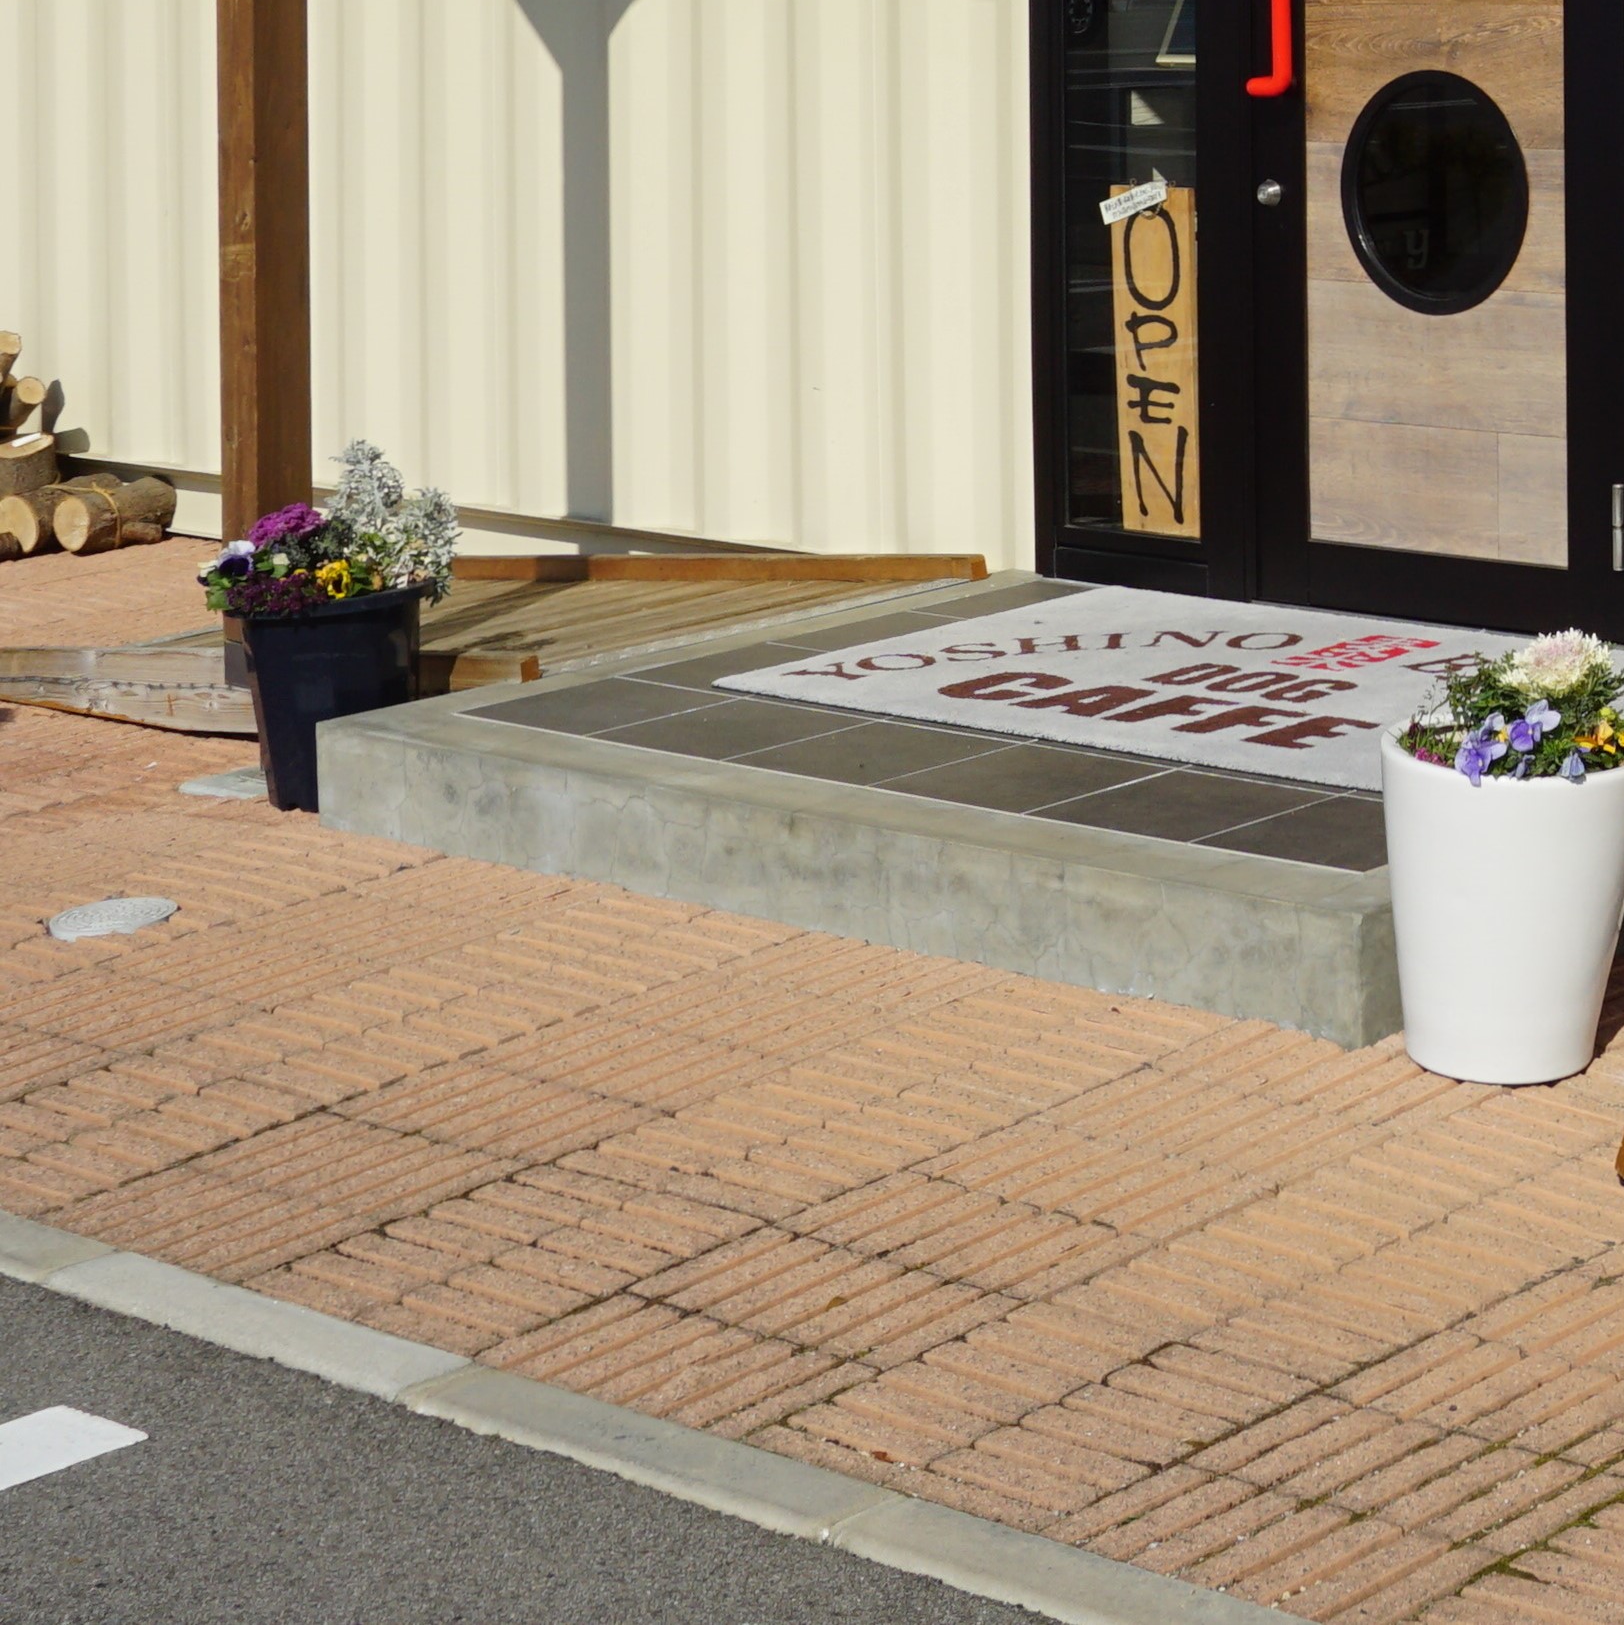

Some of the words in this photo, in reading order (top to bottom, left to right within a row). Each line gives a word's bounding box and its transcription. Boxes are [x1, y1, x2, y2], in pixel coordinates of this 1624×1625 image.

[1124, 206, 1188, 524] OPEN
[788, 630, 1303, 680] YOSHINO
[1144, 662, 1359, 704] DOG
[937, 672, 1383, 749] CAFFE
